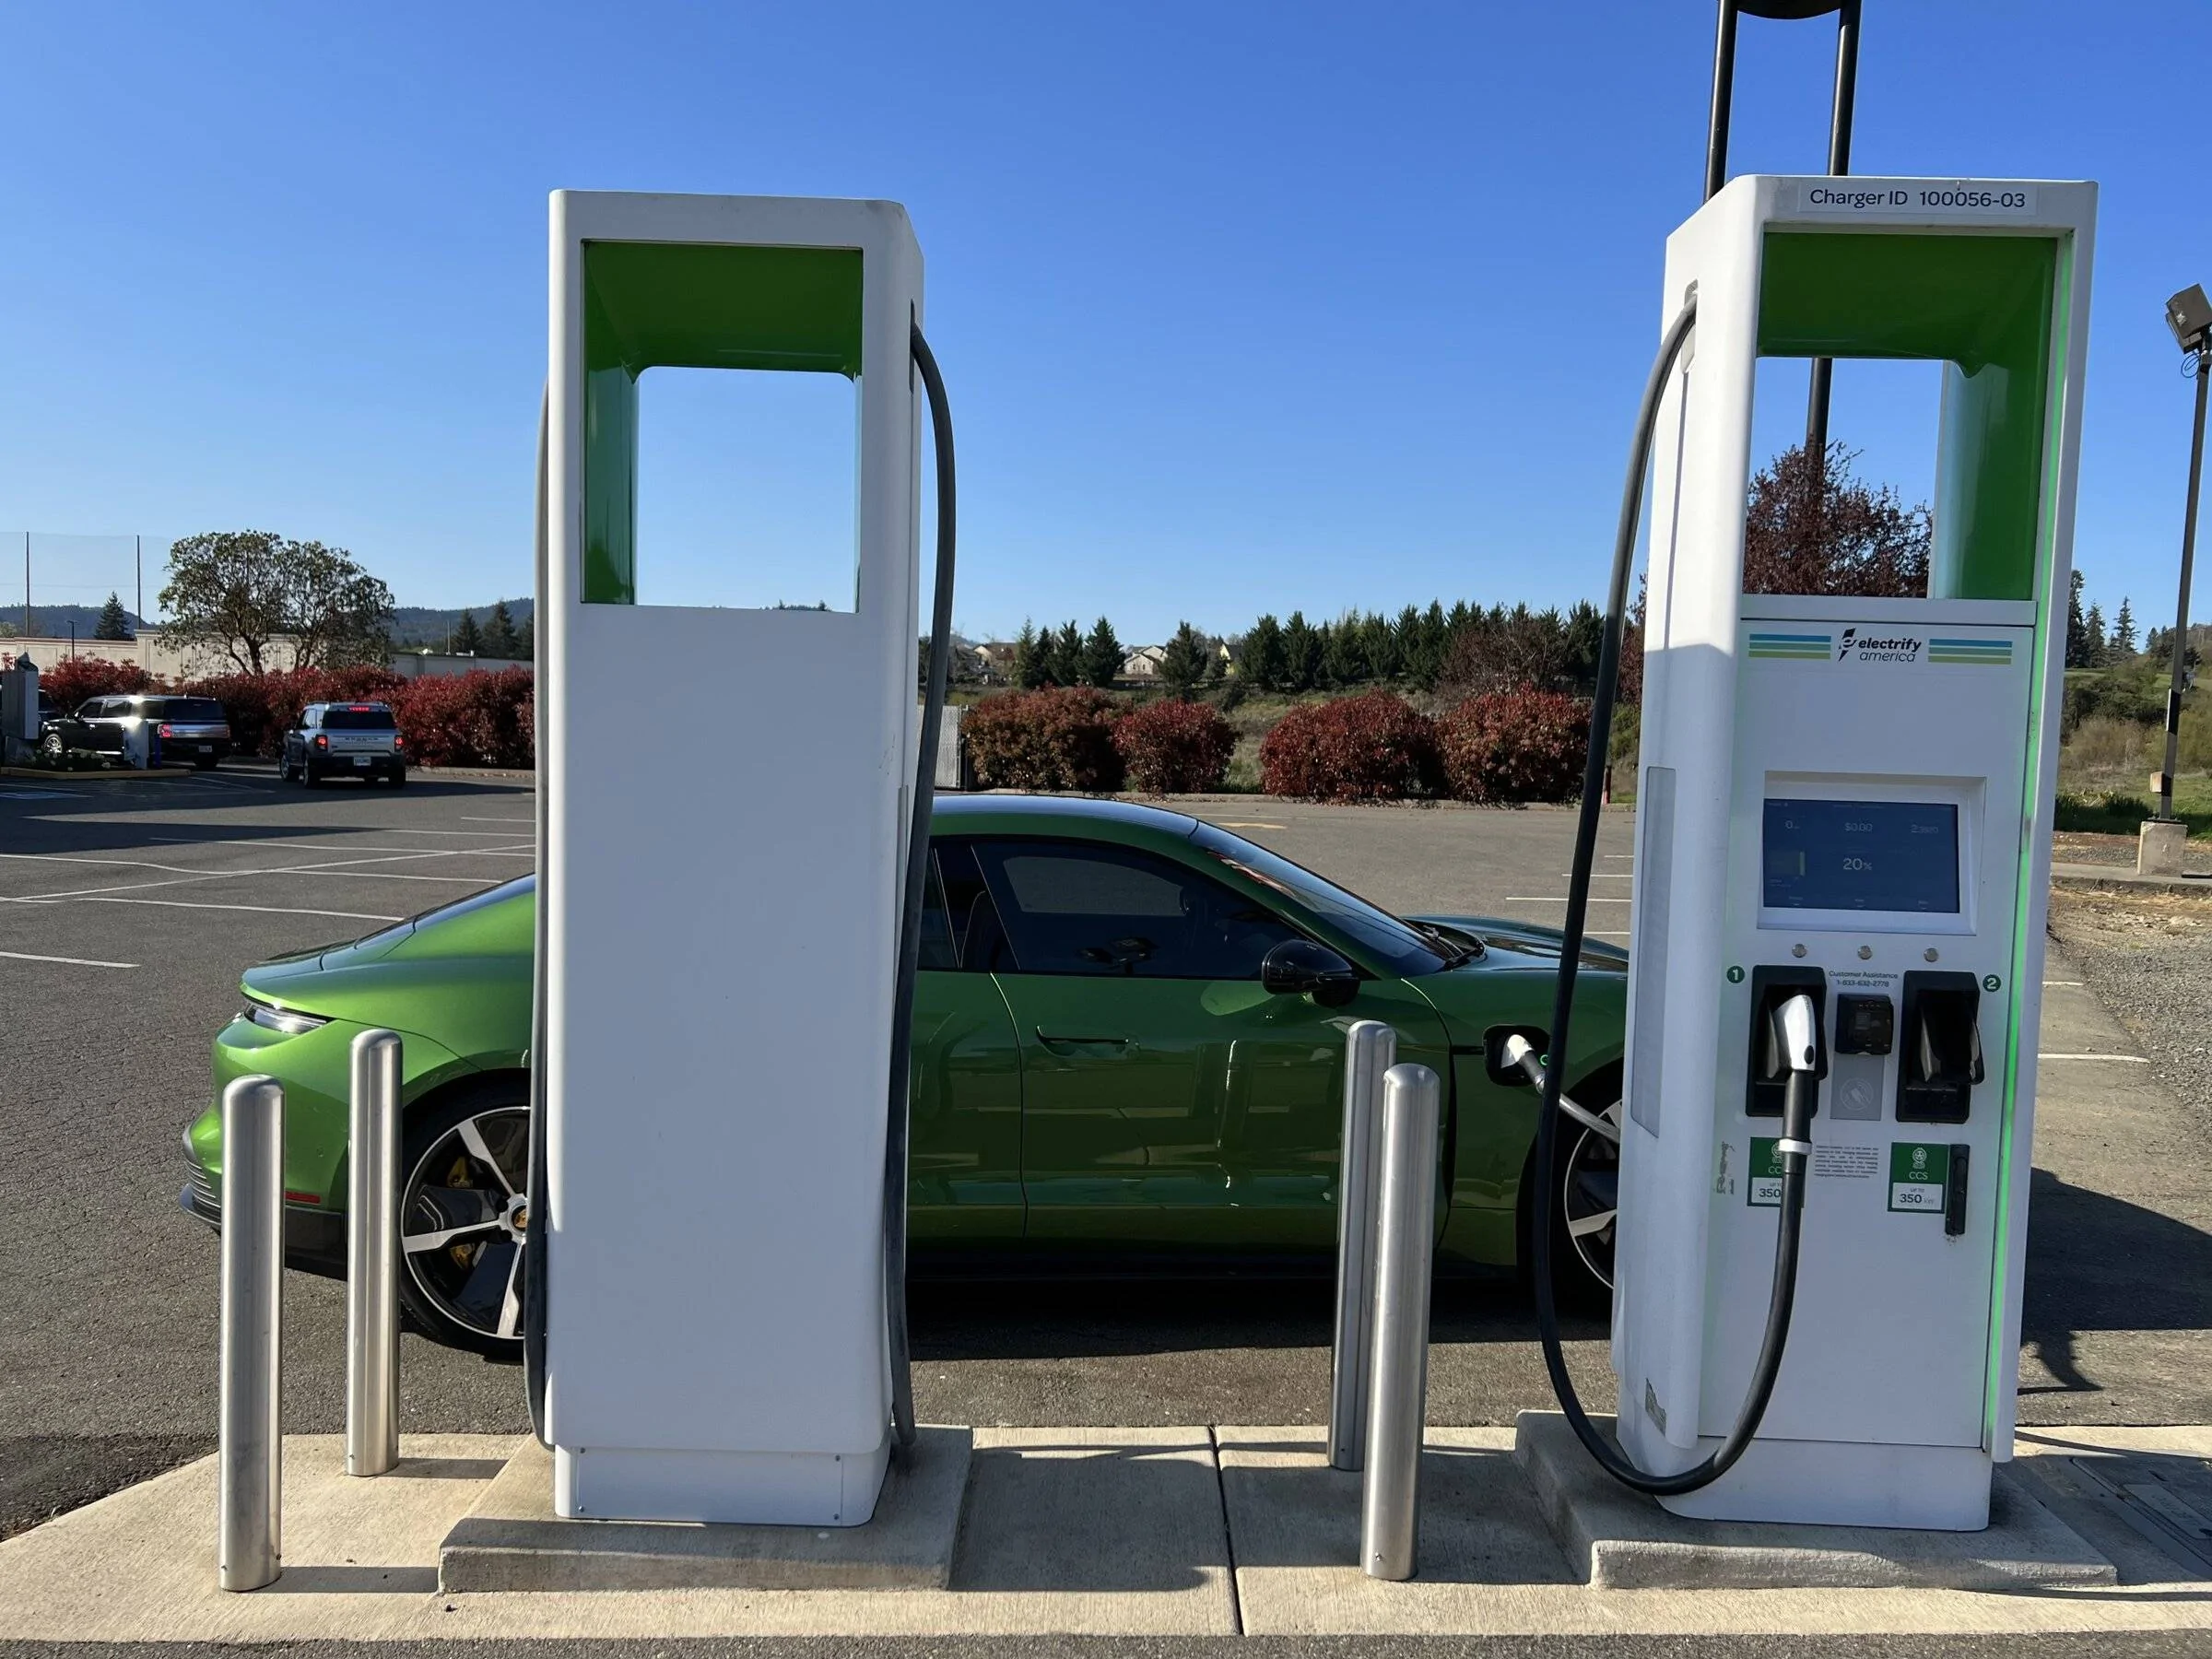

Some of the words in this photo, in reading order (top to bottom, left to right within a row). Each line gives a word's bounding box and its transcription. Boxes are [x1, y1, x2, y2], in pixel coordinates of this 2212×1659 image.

[1809, 189, 1885, 208] Charger
[1888, 191, 1908, 205] ID
[1919, 191, 2026, 207] 100056-03
[1858, 637, 1922, 653] electrify
[1859, 652, 1916, 663] america
[1732, 970, 1739, 981] 1
[1829, 971, 1862, 979] Customer
[1987, 977, 1996, 989] 2
[1768, 1165, 1782, 1174] CC
[1909, 1171, 1928, 1180] CCS
[1759, 1188, 1781, 1198] 350
[1900, 1194, 1922, 1203] 350
